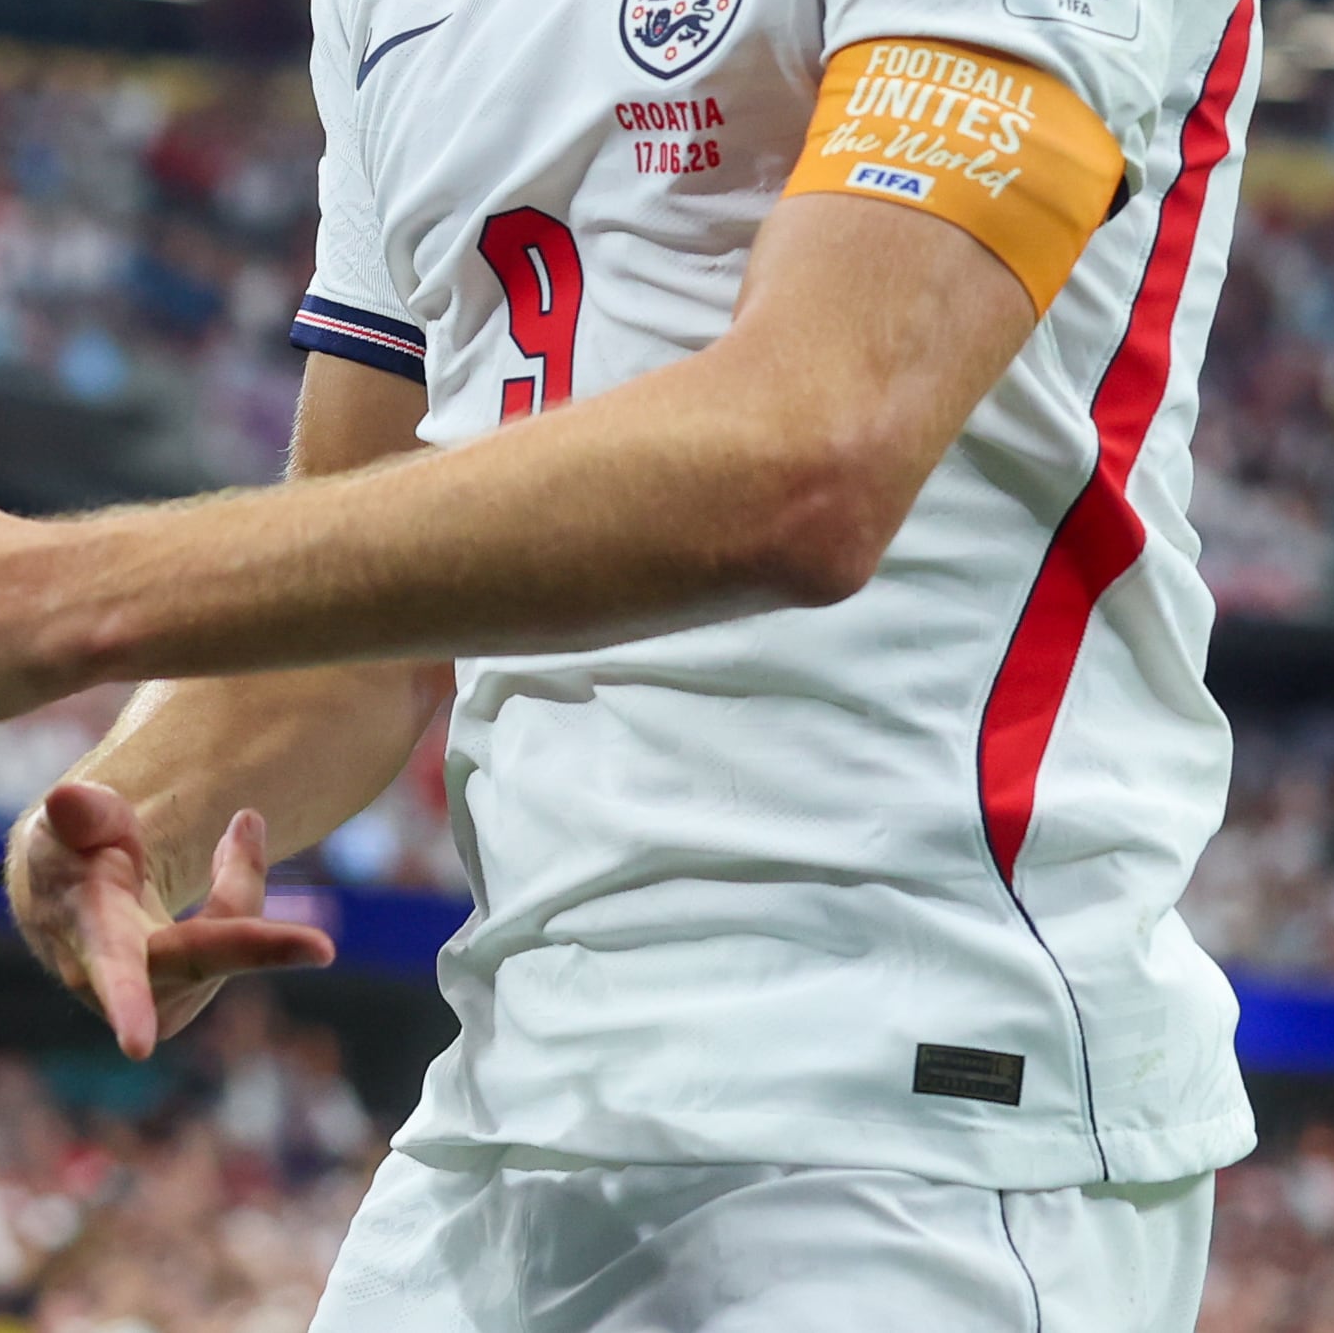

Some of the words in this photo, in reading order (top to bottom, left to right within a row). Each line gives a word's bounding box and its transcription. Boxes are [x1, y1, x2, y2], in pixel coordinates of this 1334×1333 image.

[614, 96, 726, 131] CROATIA
[845, 76, 1031, 154] UNITES
[865, 44, 1036, 119] FOOTBALL
[634, 139, 721, 175] 17.06.26
[820, 118, 882, 157] the
[882, 124, 1022, 199] World
[856, 168, 922, 196] FIFA
[477, 205, 584, 427] 9
